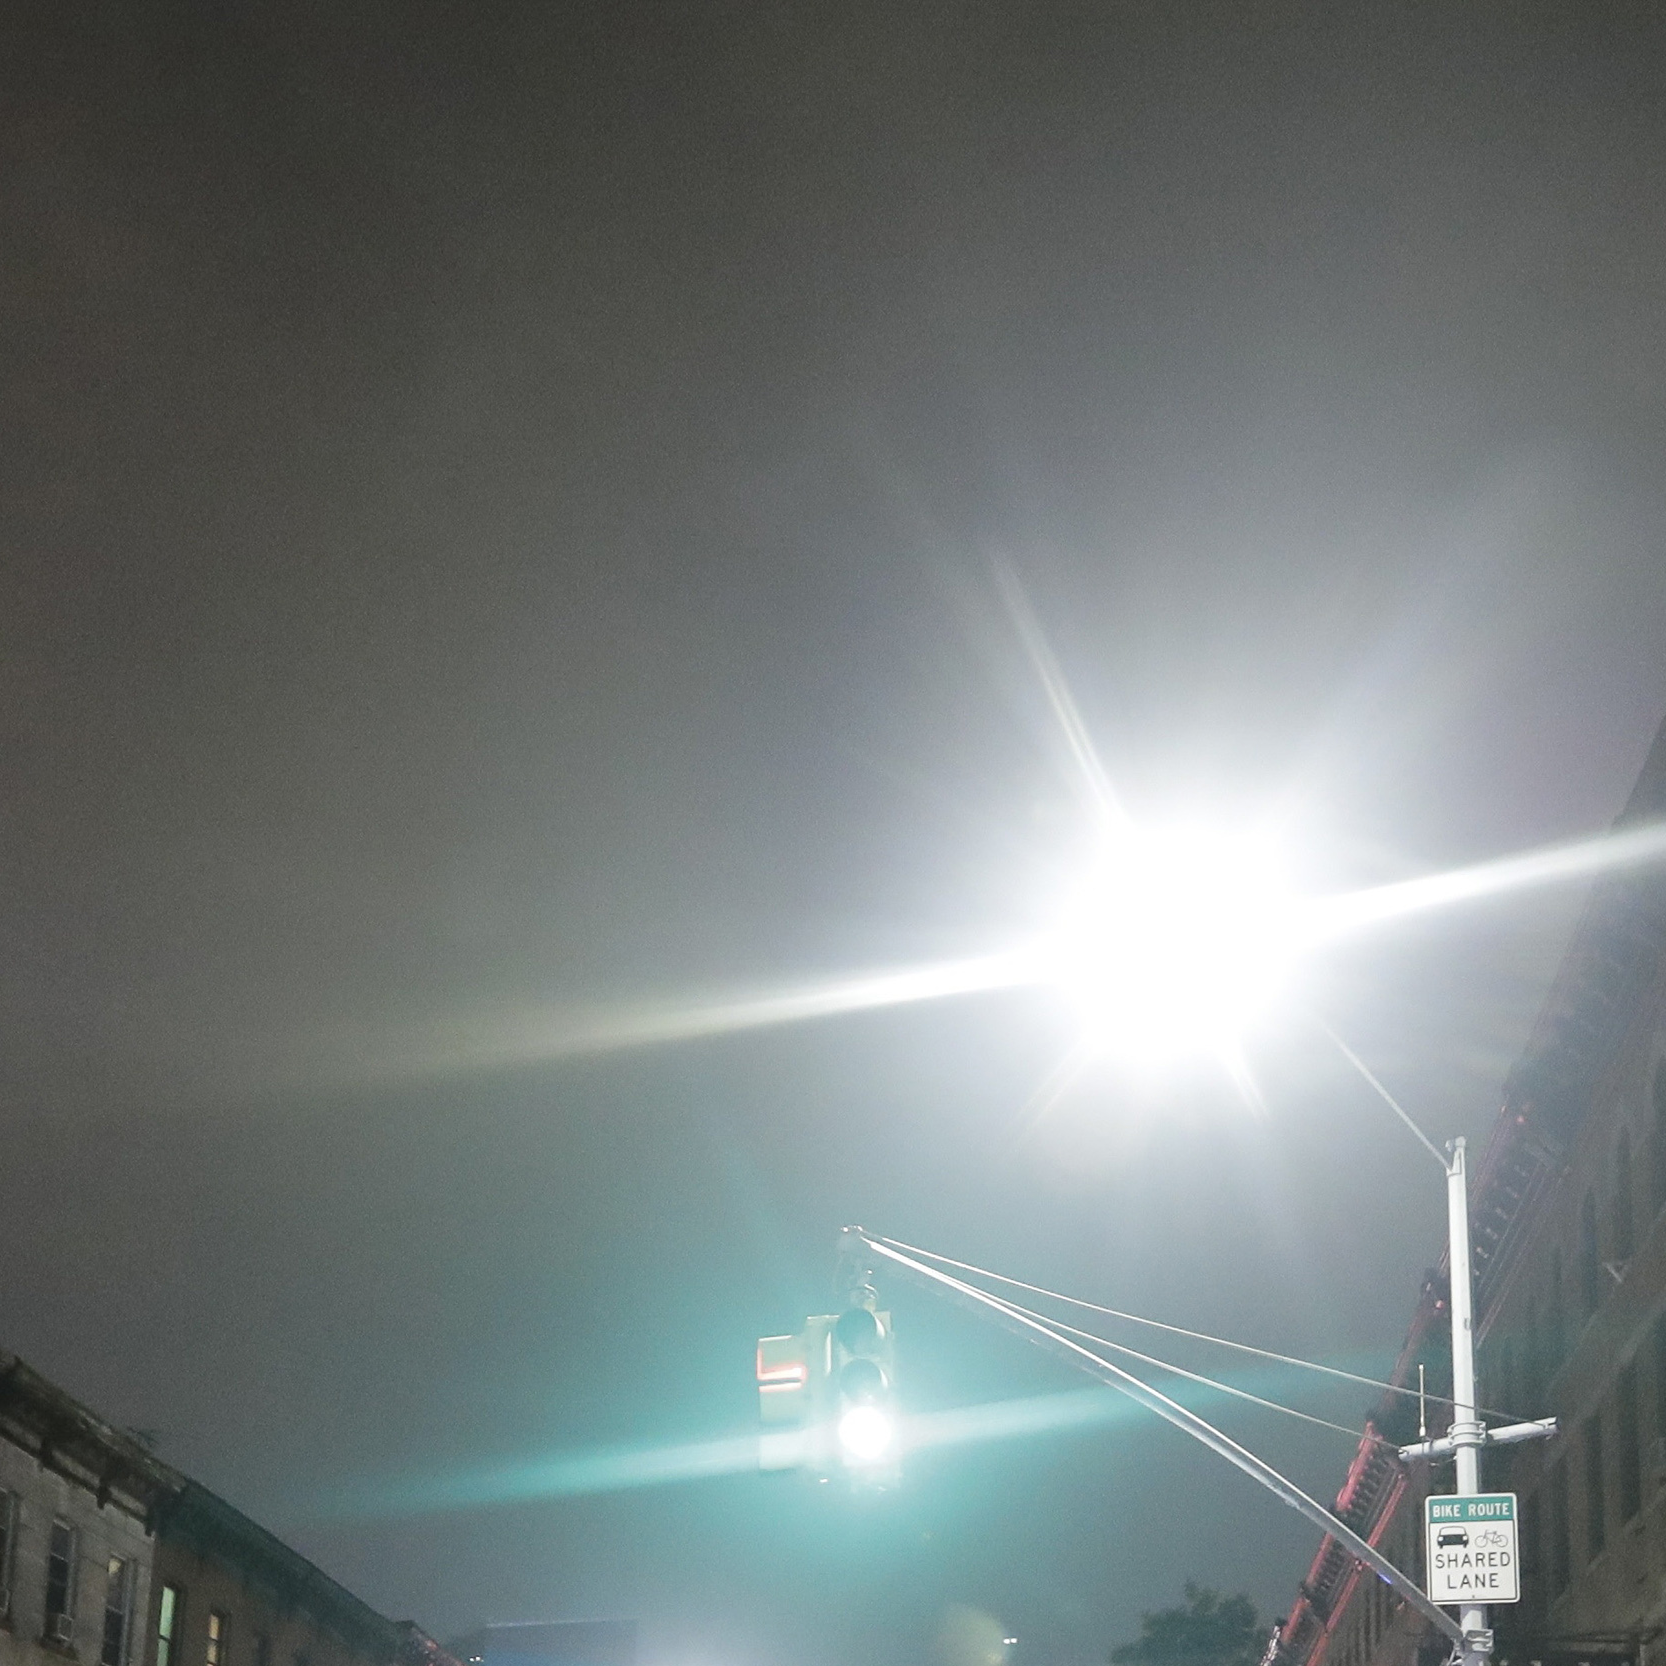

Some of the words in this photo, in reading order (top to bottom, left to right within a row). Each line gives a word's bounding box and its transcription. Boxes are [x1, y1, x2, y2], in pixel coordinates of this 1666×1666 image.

[1433, 1504, 1461, 1518] BIKE
[1468, 1502, 1510, 1517] ROUTE
[1435, 1551, 1511, 1569] SHARED
[1447, 1572, 1500, 1590] LANE
